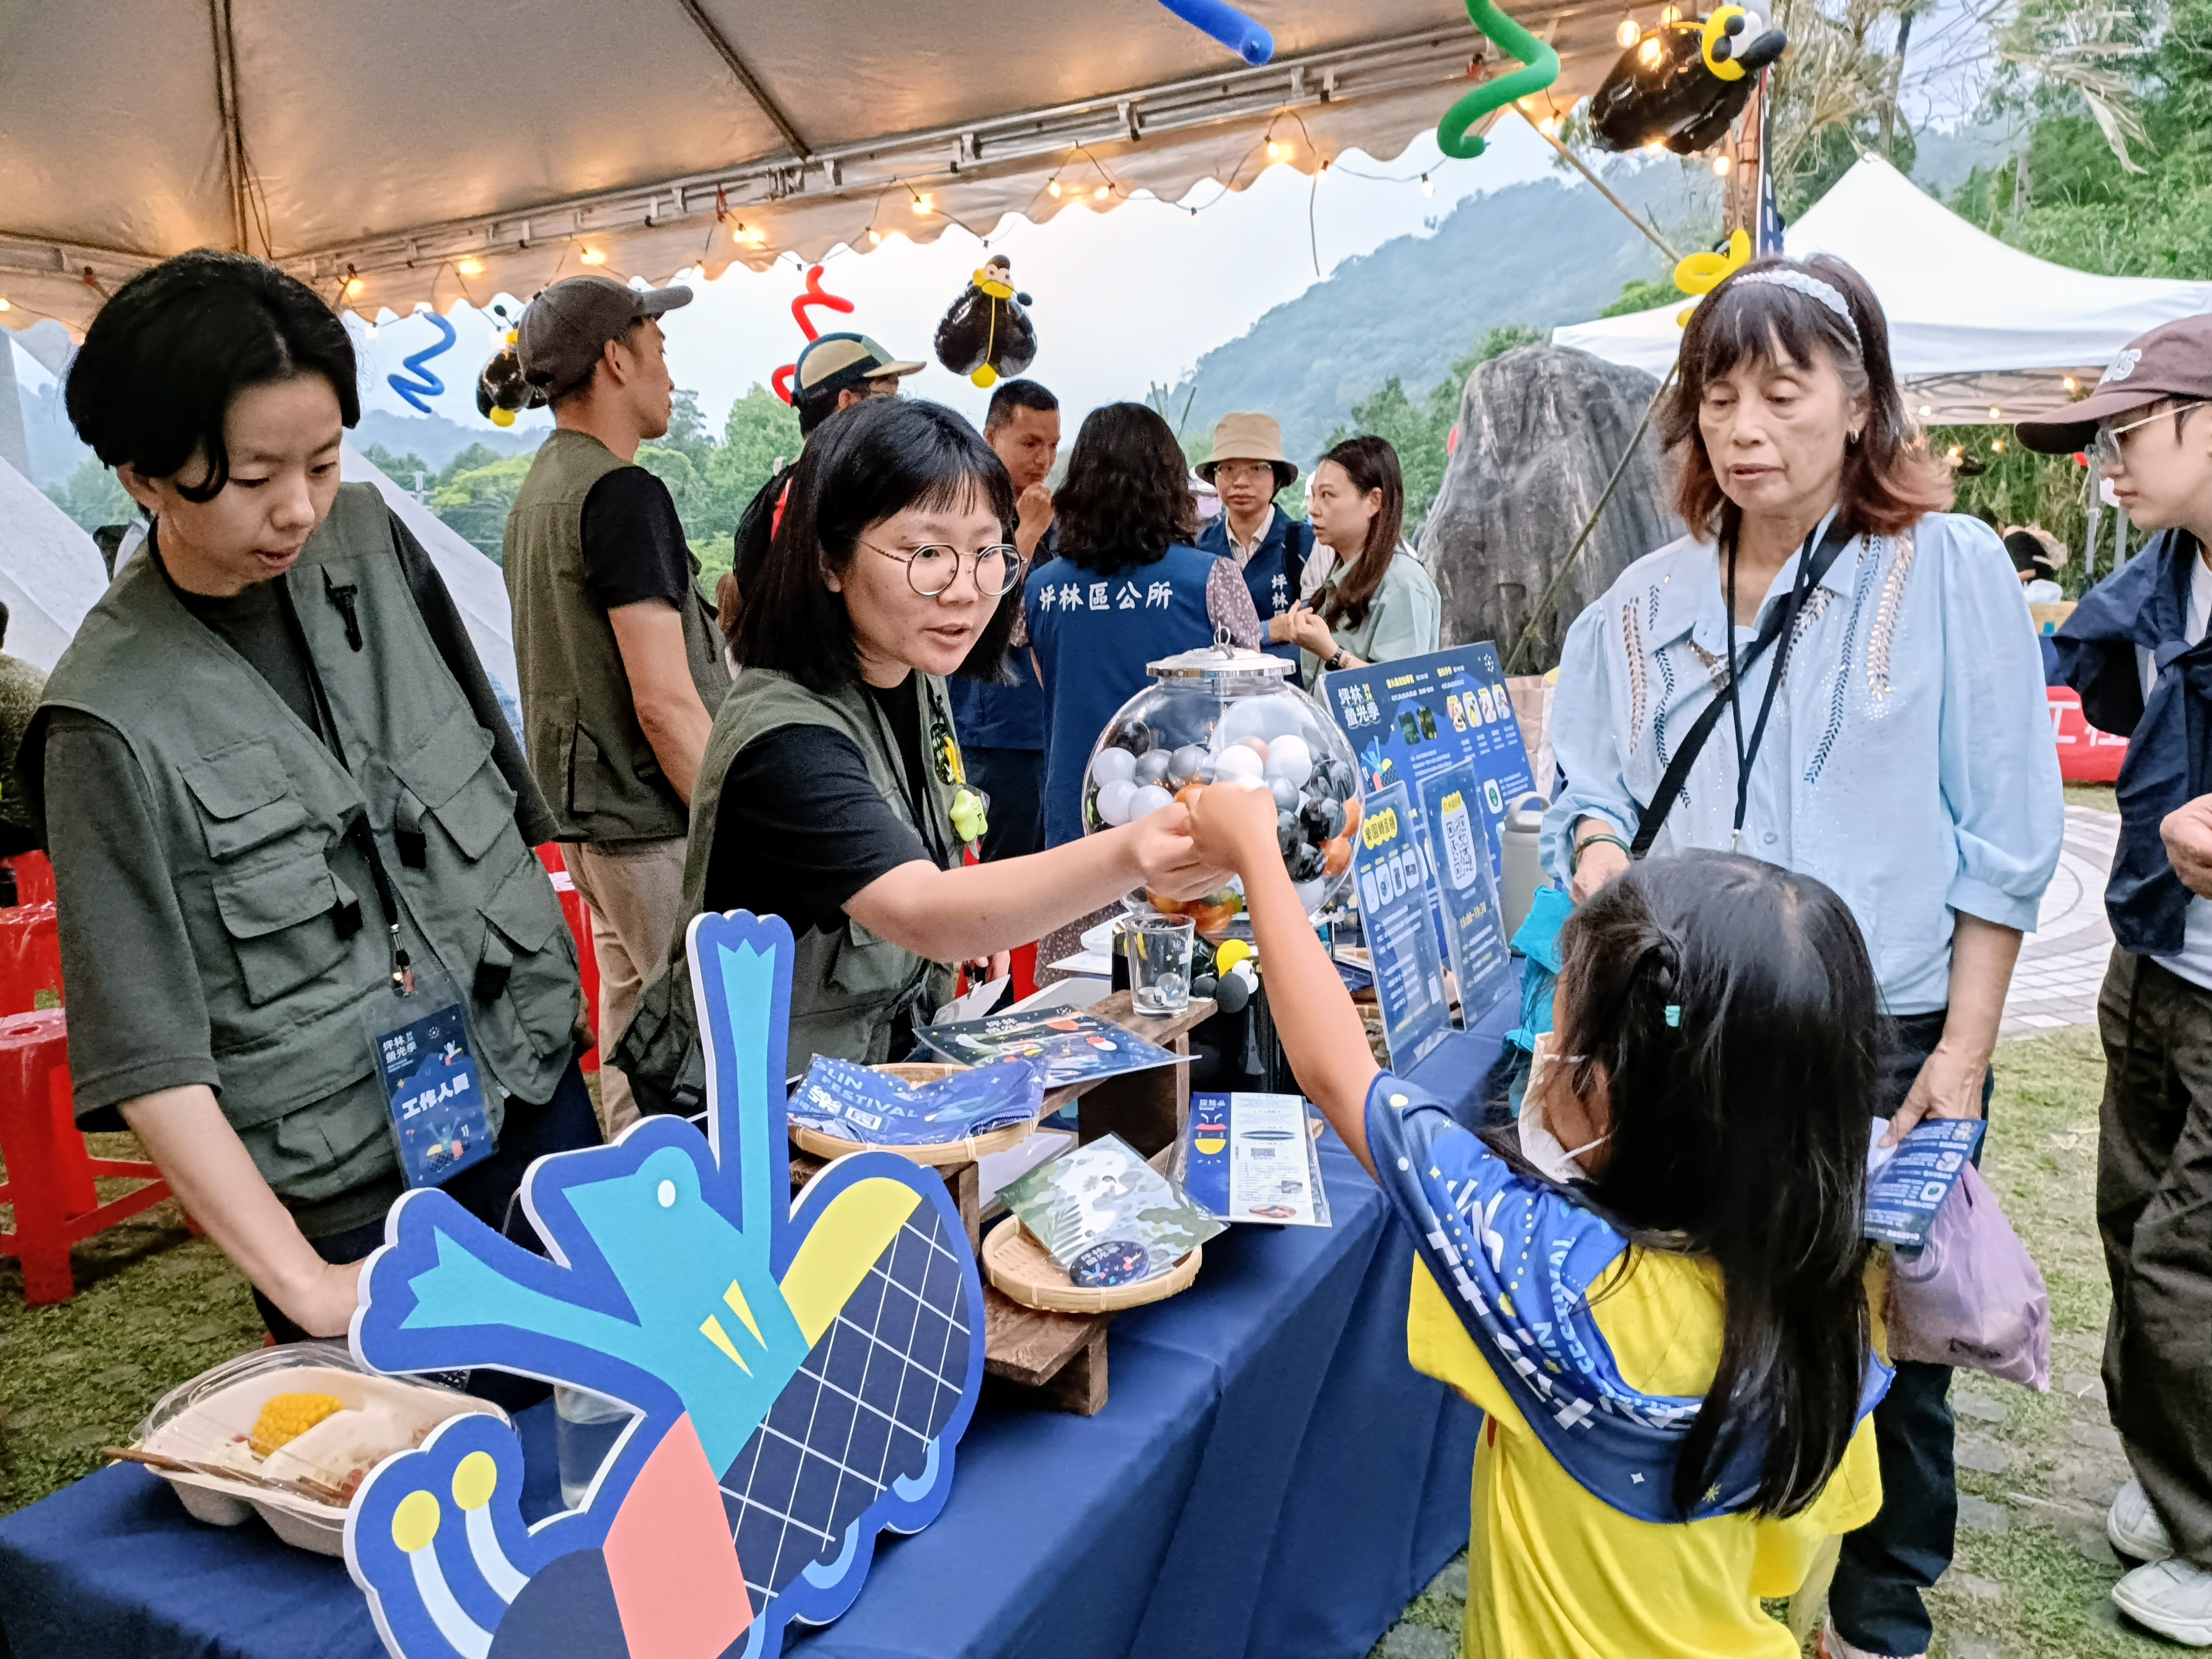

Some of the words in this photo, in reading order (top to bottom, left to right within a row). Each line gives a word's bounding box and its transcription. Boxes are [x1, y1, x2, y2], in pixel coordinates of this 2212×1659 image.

[1039, 580, 1173, 613] 坪林區公所
[1338, 684, 1363, 707] 坪林
